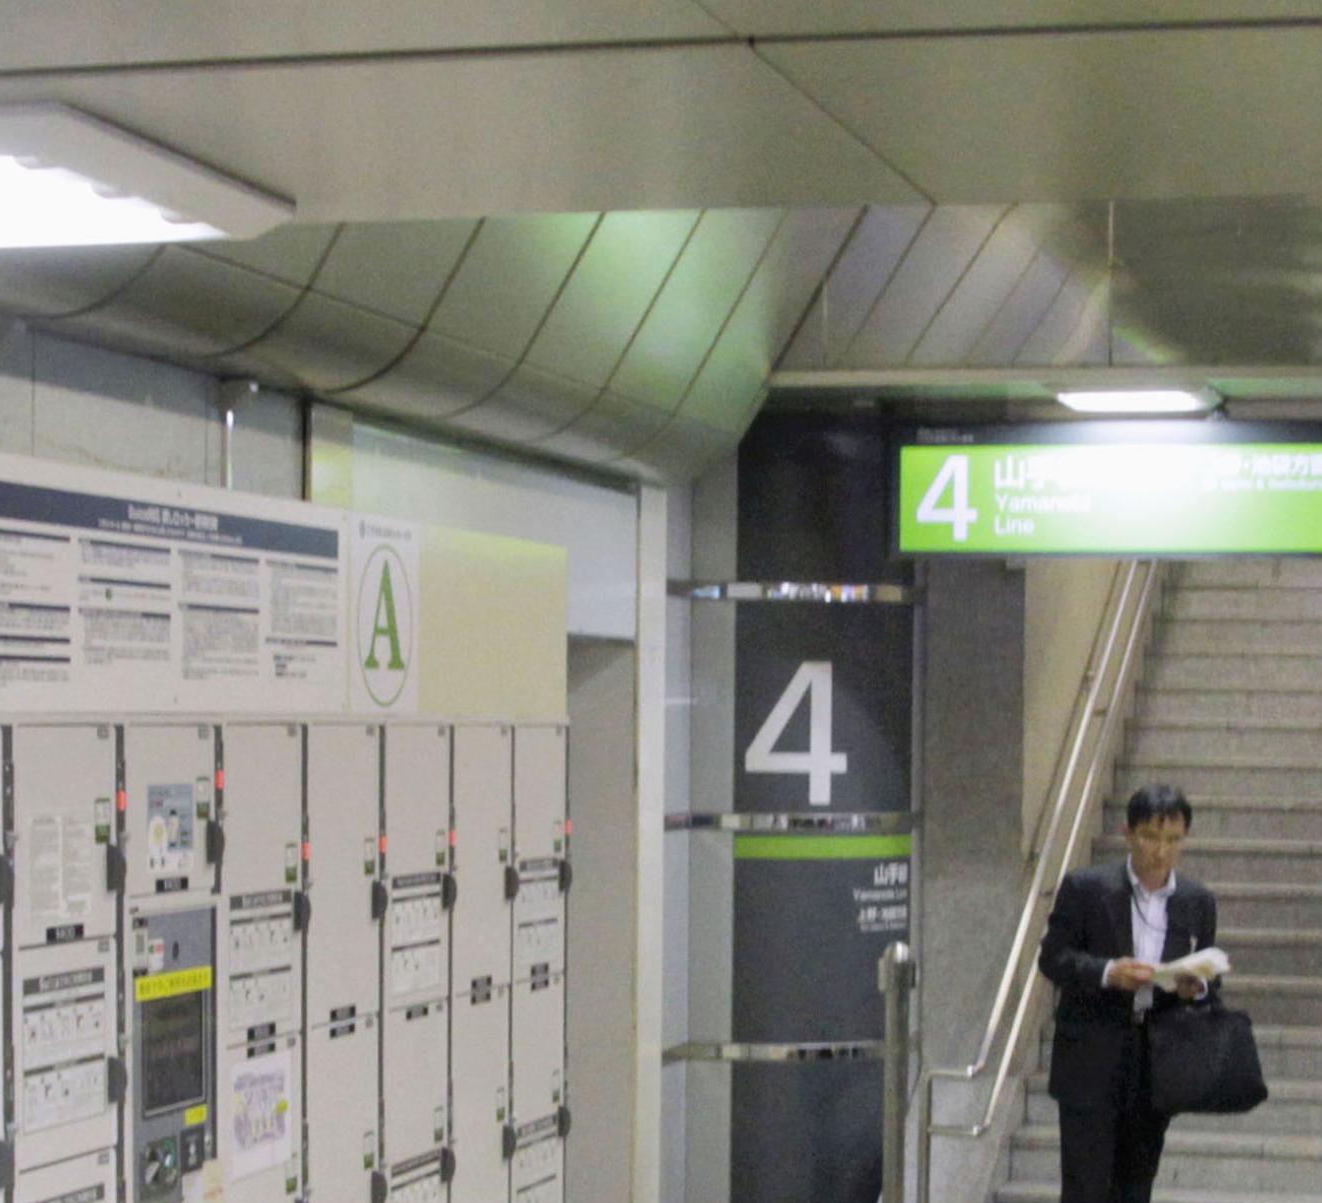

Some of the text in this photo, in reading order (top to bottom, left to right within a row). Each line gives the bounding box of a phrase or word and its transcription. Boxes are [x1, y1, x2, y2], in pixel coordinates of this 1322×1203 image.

[916, 454, 978, 542] 4
[994, 516, 1035, 535] Line
[364, 560, 405, 671] A
[744, 660, 848, 806] 4
